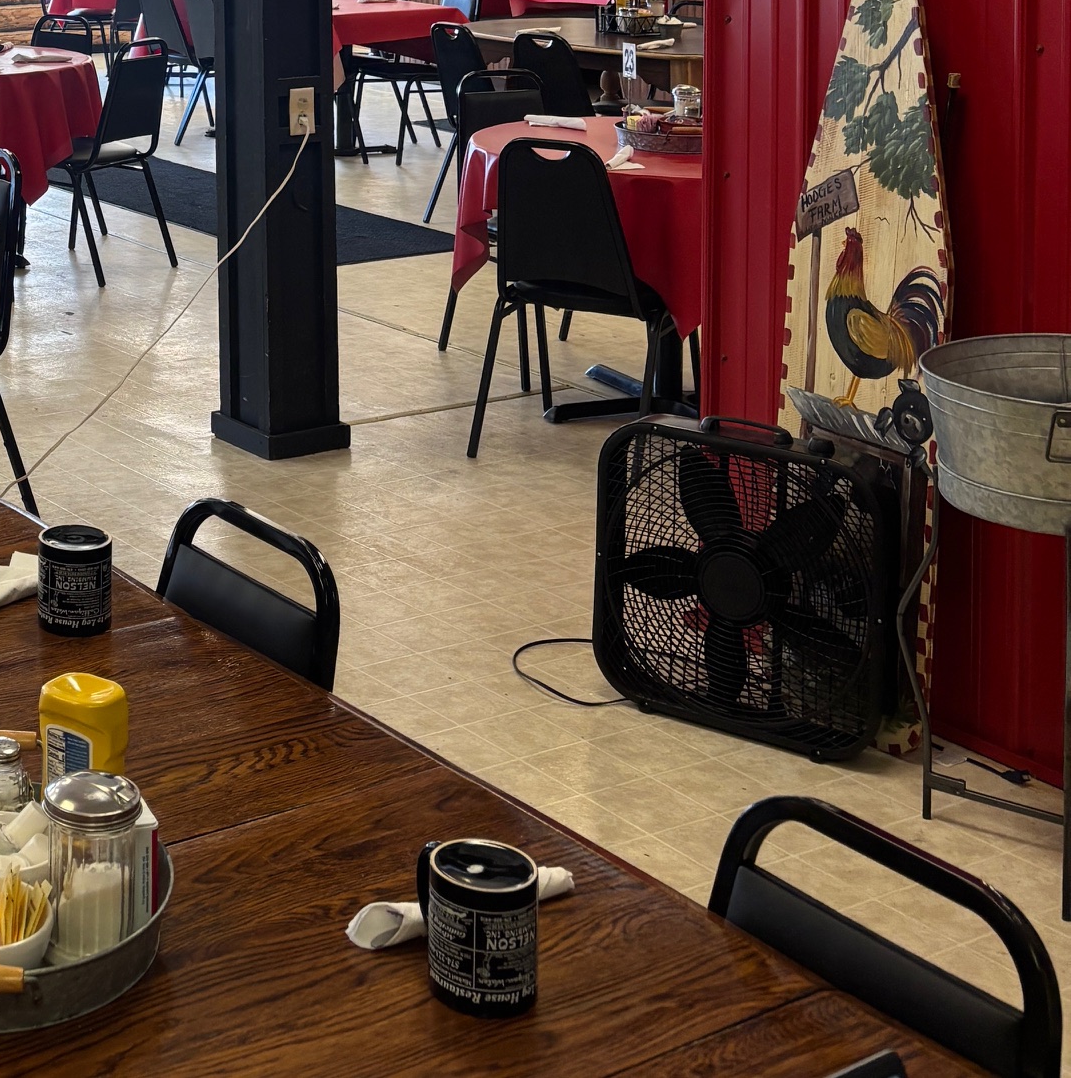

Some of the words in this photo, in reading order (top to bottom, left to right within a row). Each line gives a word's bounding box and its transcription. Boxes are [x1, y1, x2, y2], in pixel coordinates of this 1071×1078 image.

[624, 48, 634, 73] 23
[801, 178, 842, 212] HODGES
[809, 195, 842, 223] FARM
[55, 581, 96, 591] NELSON
[54, 619, 80, 629] House
[81, 618, 97, 627] Log
[486, 930, 535, 950] NELSON
[484, 991, 520, 1004] House
